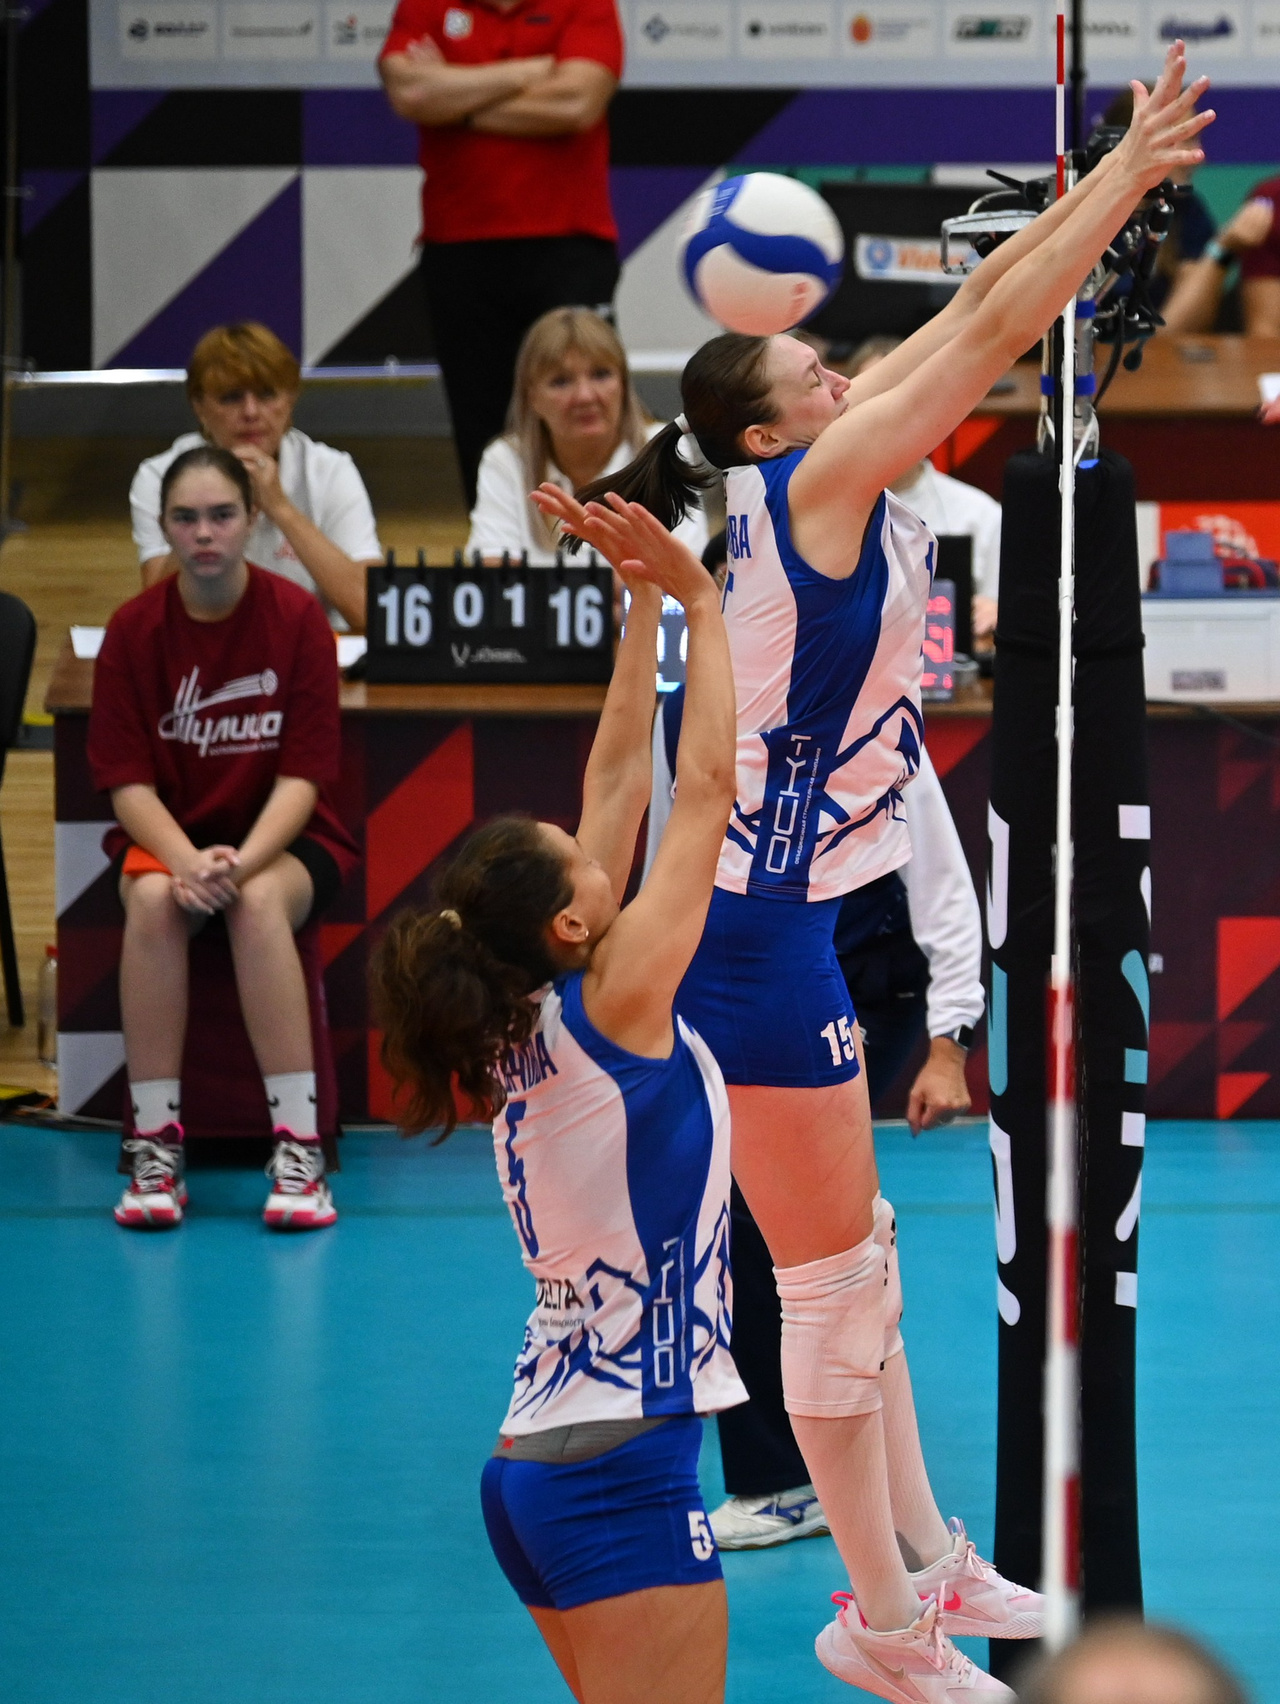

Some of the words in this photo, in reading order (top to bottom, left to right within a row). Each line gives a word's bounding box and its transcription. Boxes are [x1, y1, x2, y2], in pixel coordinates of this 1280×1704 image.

[377, 583, 433, 647] 16
[453, 581, 485, 628] 0
[502, 582, 526, 628] 1
[548, 584, 604, 647] 16
[765, 733, 812, 875] ОСК-1
[820, 1015, 856, 1067] 15
[688, 1510, 715, 1561] 5
